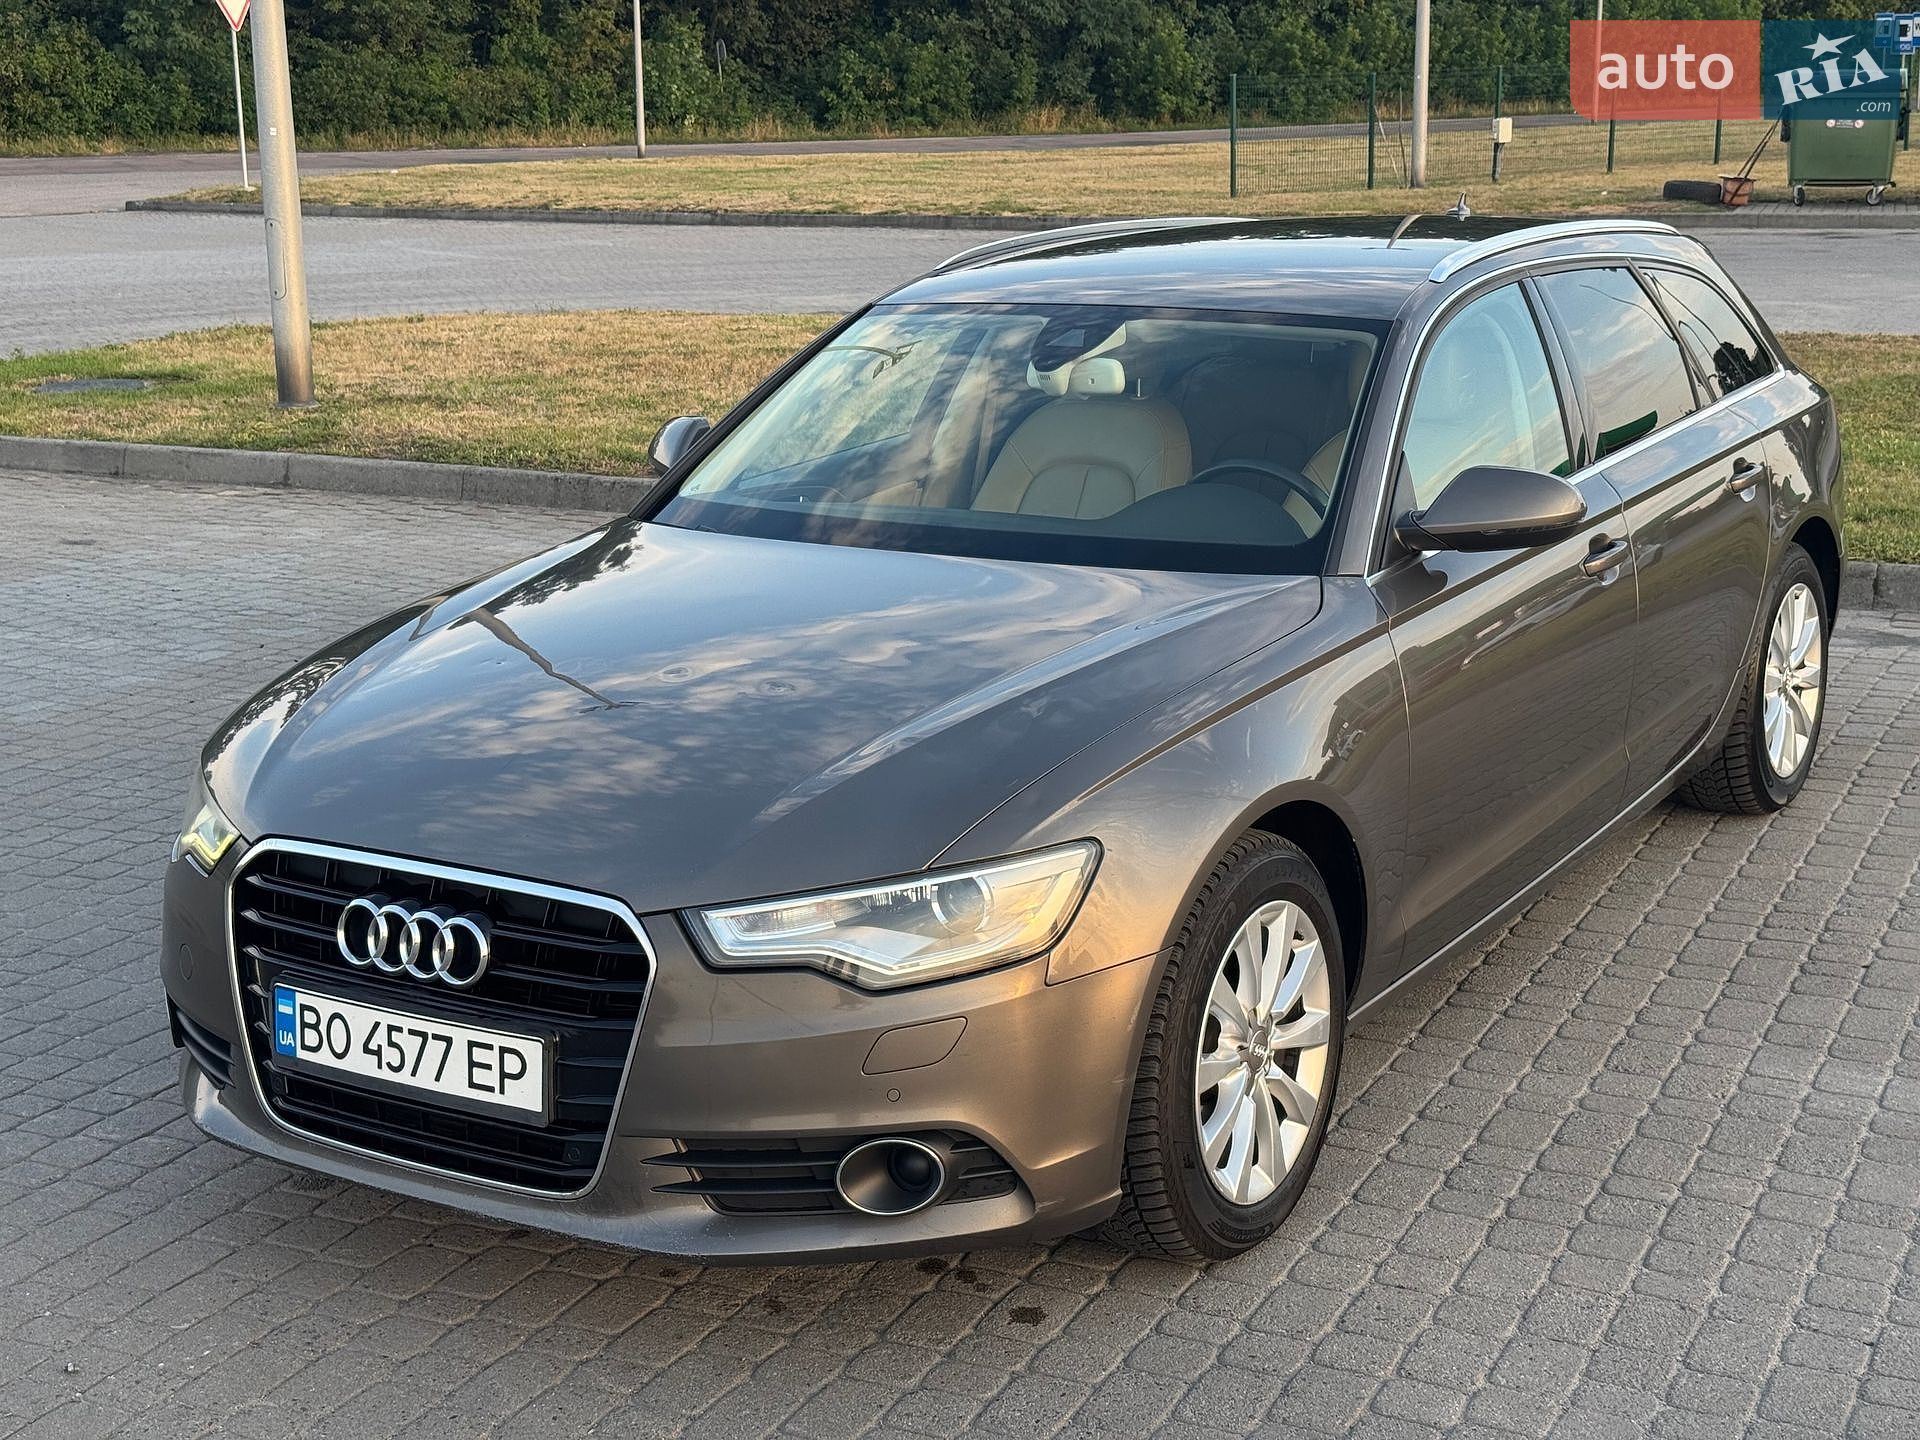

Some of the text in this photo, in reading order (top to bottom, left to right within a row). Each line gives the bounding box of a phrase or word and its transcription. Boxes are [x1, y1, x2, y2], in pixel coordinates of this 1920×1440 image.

[279, 1030, 295, 1047] UA
[299, 1002, 528, 1095] BO 4577 EP
